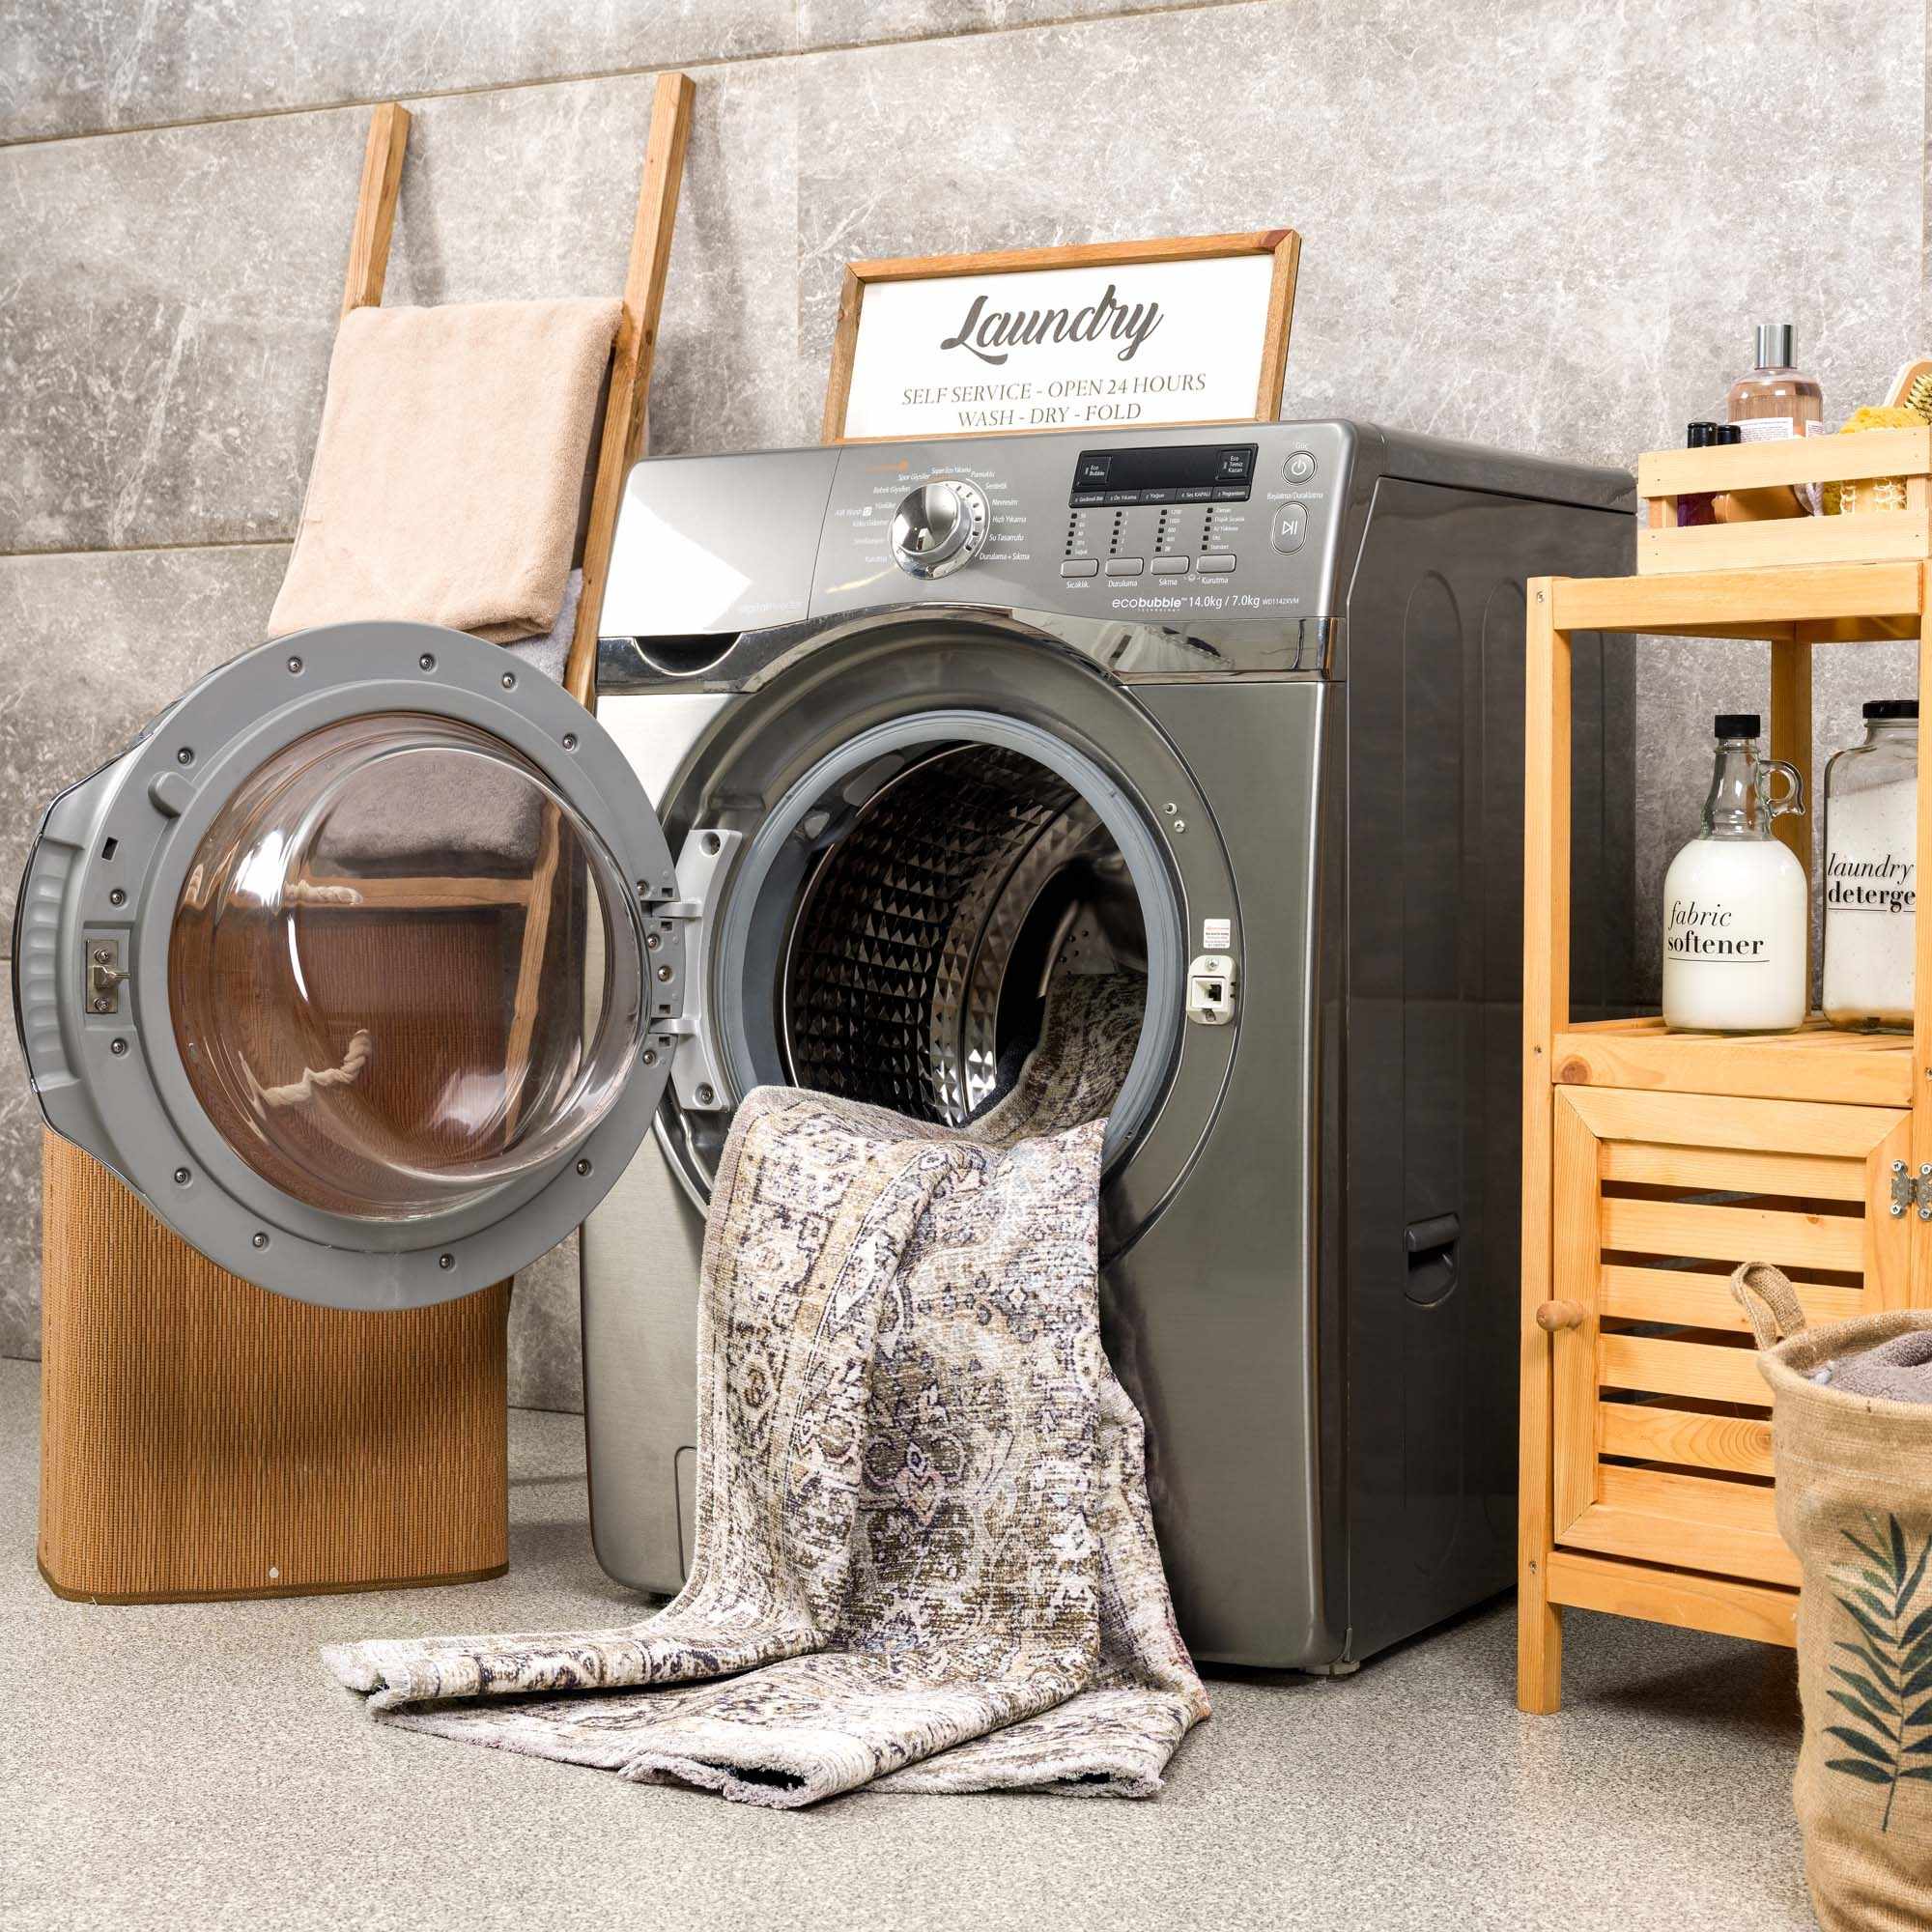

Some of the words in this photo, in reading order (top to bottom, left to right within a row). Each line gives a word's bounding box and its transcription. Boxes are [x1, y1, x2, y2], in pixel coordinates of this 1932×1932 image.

[940, 284, 1164, 365] Laundry
[901, 387, 948, 406] SELF
[951, 383, 1032, 403] SERVICE
[1048, 379, 1103, 398] OPEN
[1107, 378, 1128, 395] 24
[1133, 373, 1207, 393] HOURS
[958, 410, 1014, 427] WASH
[1030, 407, 1069, 424] DRY
[1086, 403, 1142, 421] FOLD
[1189, 595, 1223, 610] 14.0kg
[1233, 594, 1260, 609] 7.0kg
[1828, 853, 1915, 885] laundry
[1828, 880, 1917, 913] deterge
[1668, 900, 1732, 931] fabric
[1667, 929, 1764, 954] softener
